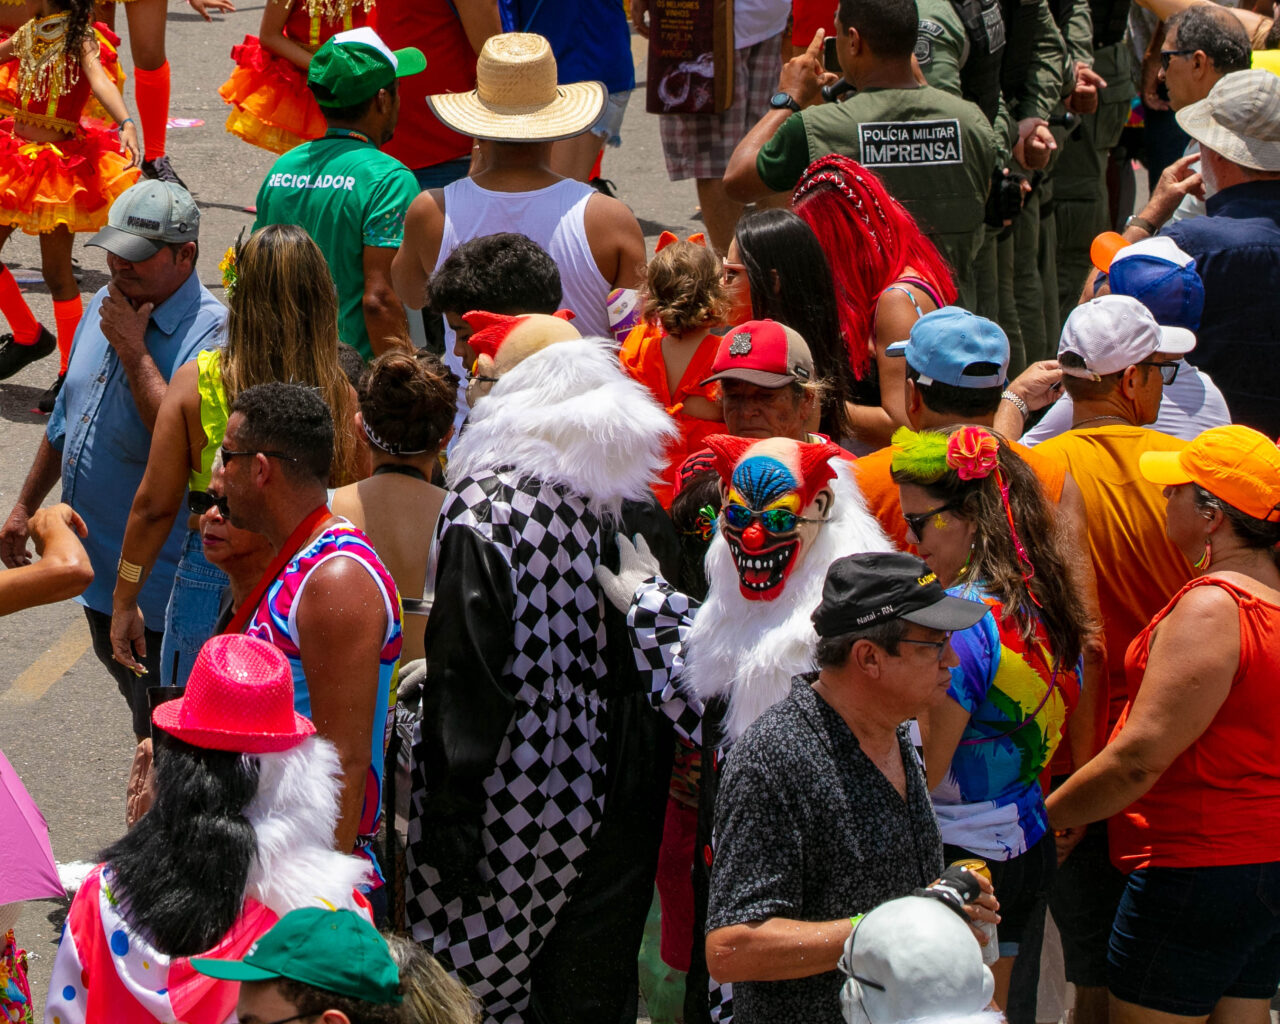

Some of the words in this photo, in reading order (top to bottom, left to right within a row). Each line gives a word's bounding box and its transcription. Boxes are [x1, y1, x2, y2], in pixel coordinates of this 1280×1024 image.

[666, 1, 699, 10] MELHORES
[863, 126, 909, 142] POLÍCIA
[913, 126, 955, 140] MILITAR
[865, 141, 958, 163] IMPRENSA
[268, 173, 356, 191] RECICLADOR
[856, 611, 876, 625] Natal
[881, 604, 895, 616] RN
